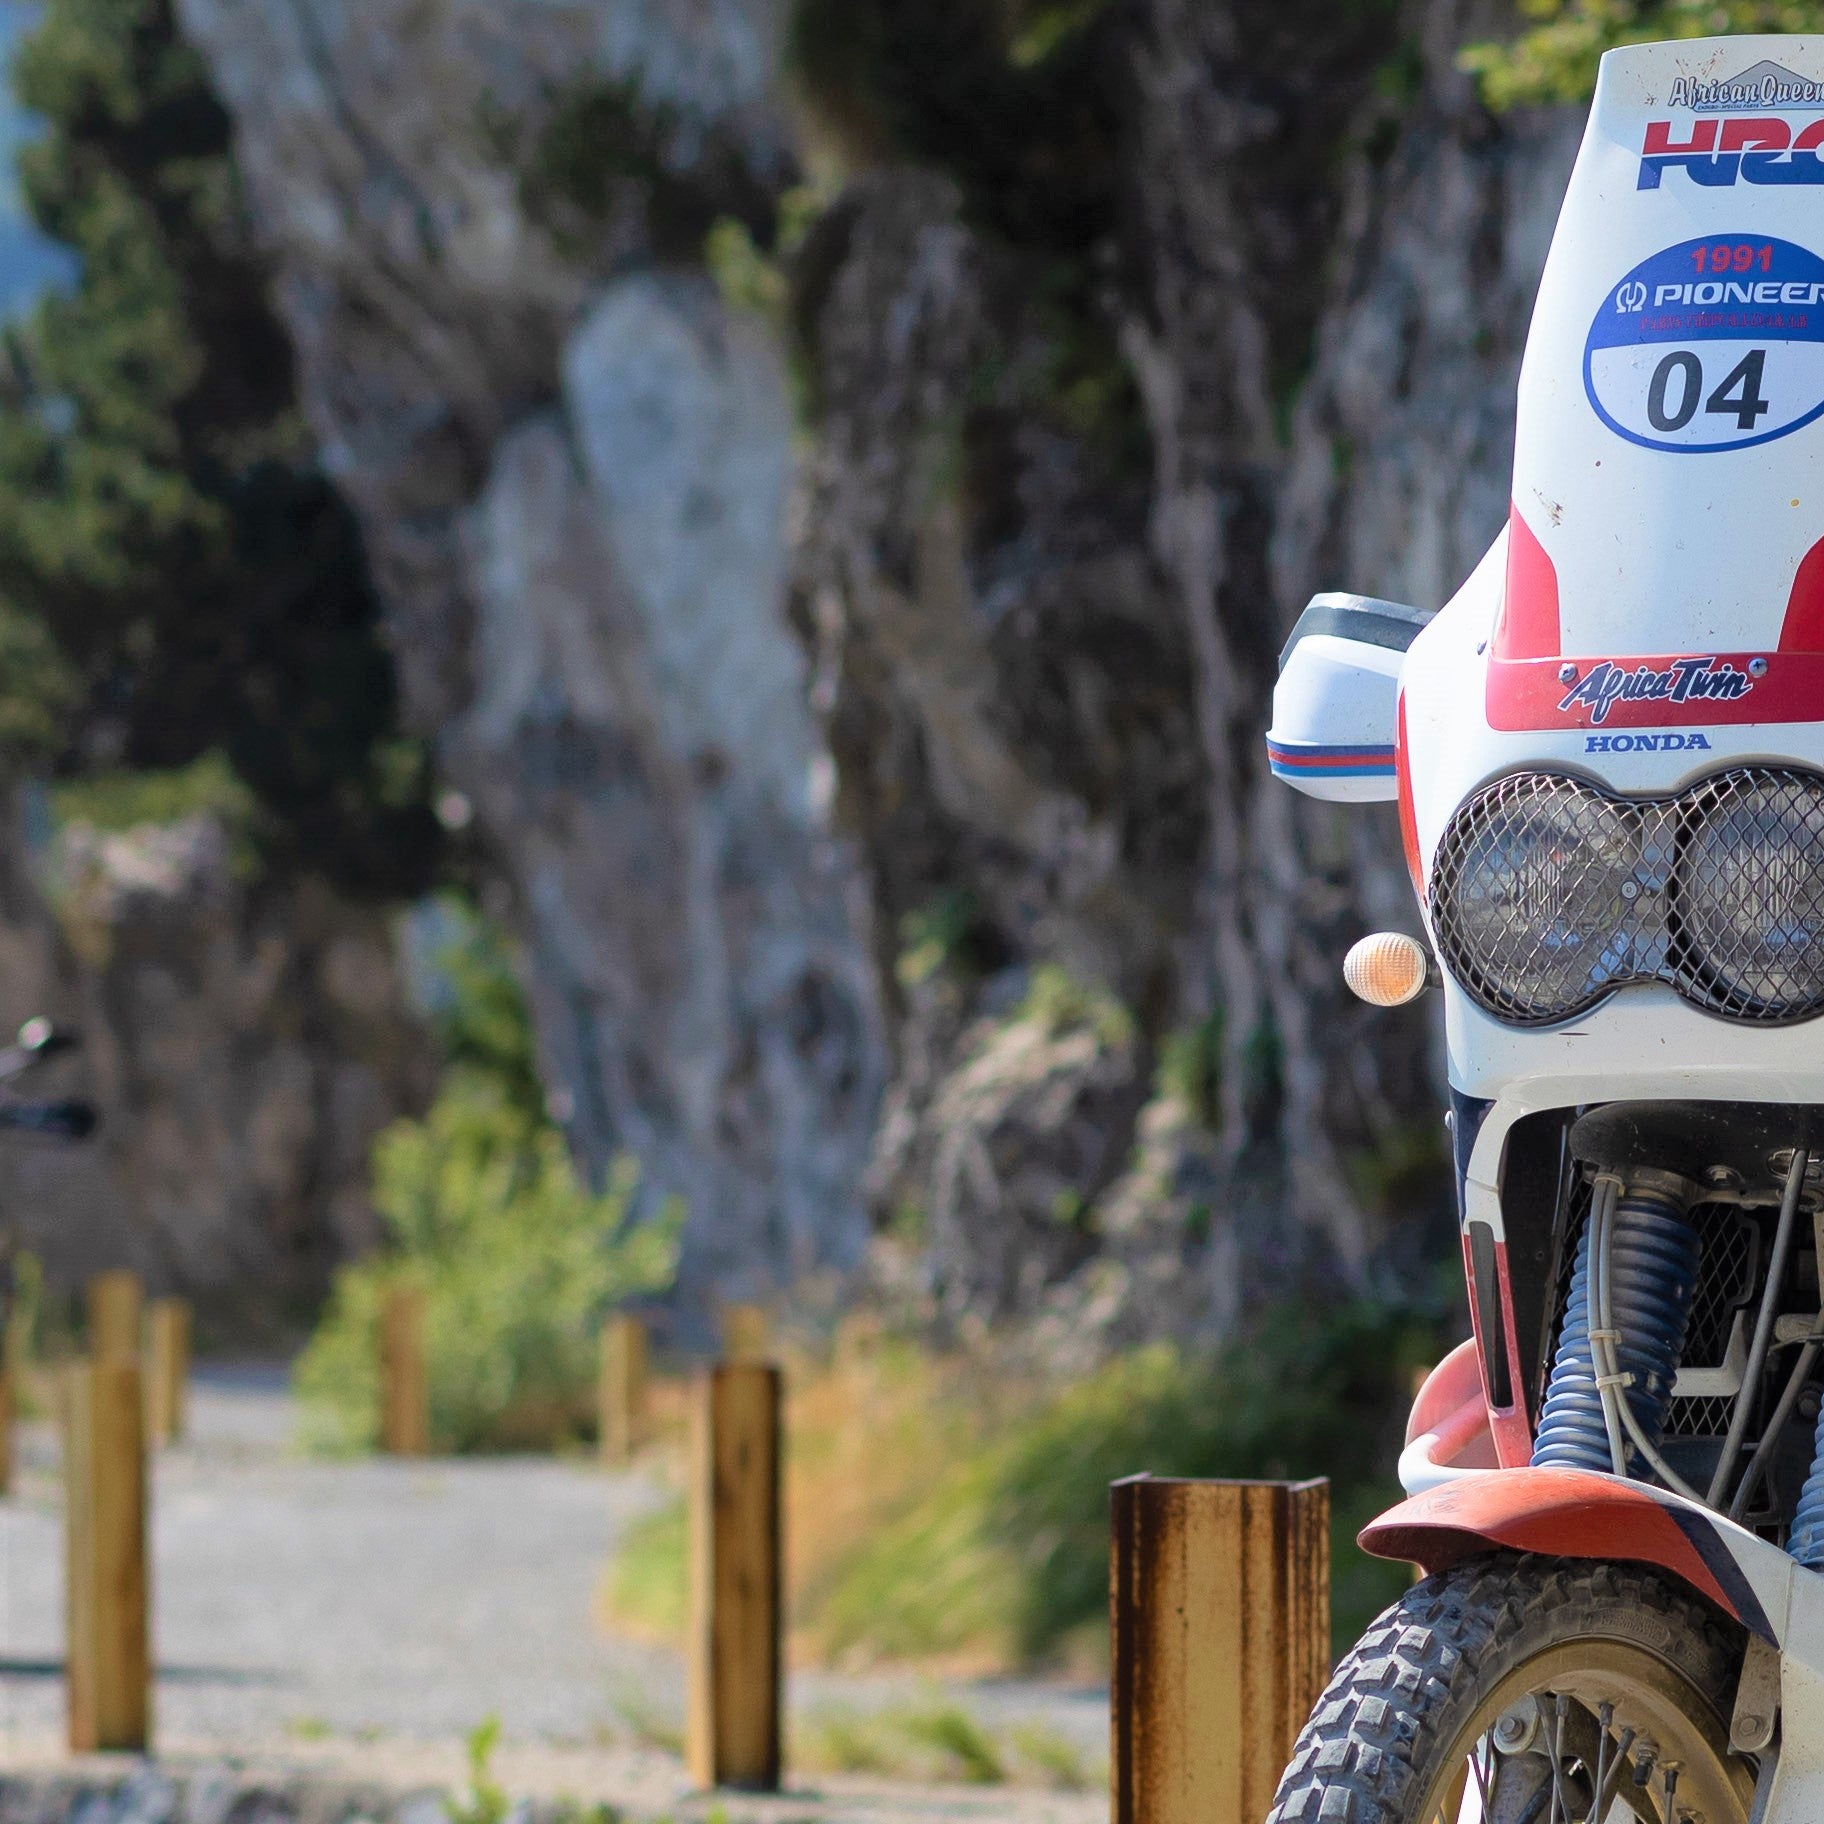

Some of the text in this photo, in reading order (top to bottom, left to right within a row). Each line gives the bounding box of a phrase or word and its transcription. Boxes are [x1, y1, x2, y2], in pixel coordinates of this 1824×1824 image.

[1691, 245, 1773, 274] 1991
[1646, 349, 1769, 431] 04
[1557, 656, 1754, 723] Africa Twin
[1585, 733, 1711, 752] HONDA
